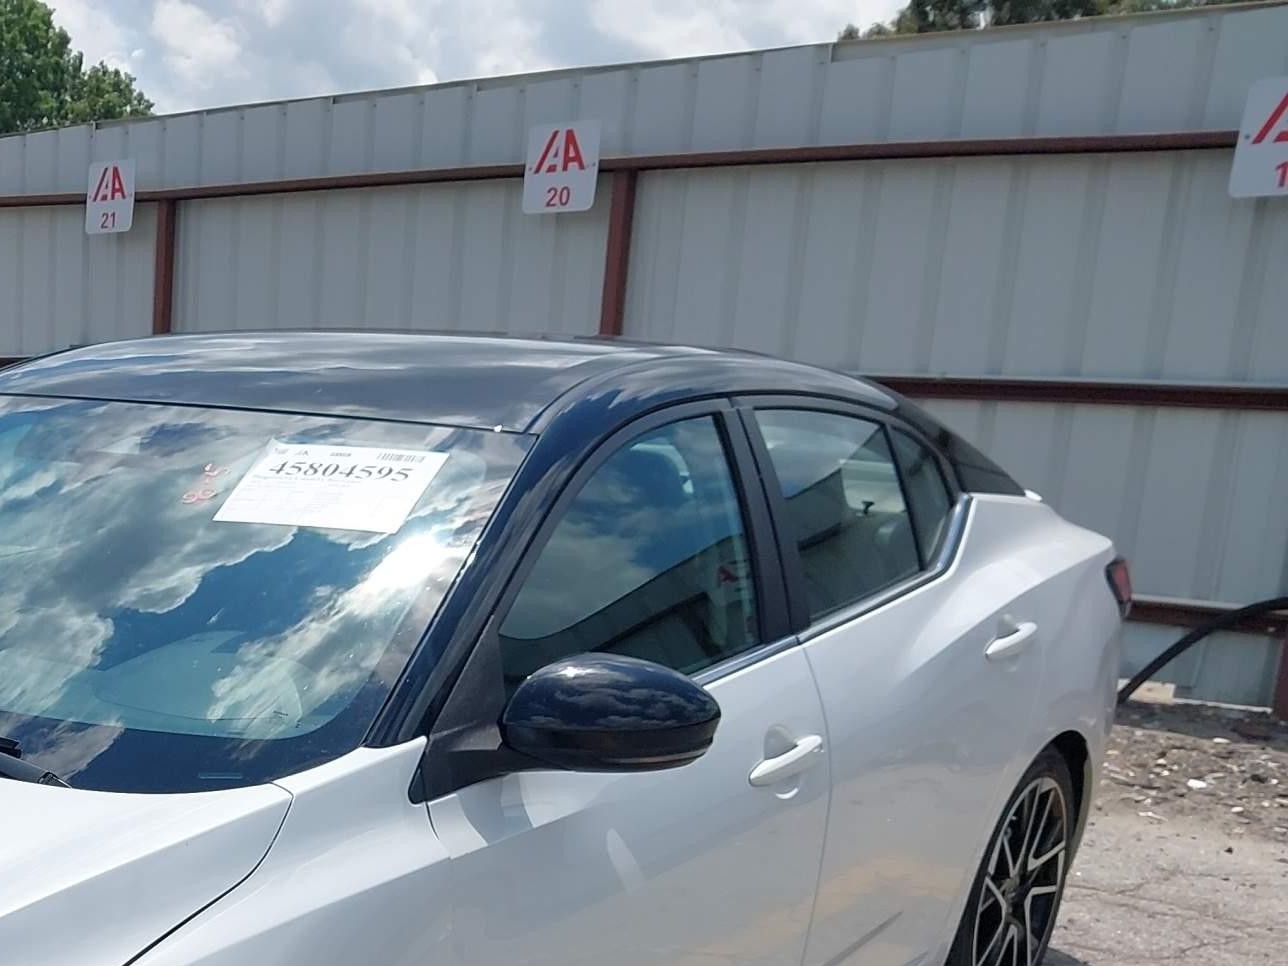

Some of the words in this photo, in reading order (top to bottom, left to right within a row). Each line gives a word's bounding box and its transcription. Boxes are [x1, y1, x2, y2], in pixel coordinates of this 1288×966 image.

[1275, 161, 1288, 188] 1
[546, 186, 570, 208] 20
[100, 211, 115, 228] 21
[269, 460, 414, 482] 45804595
